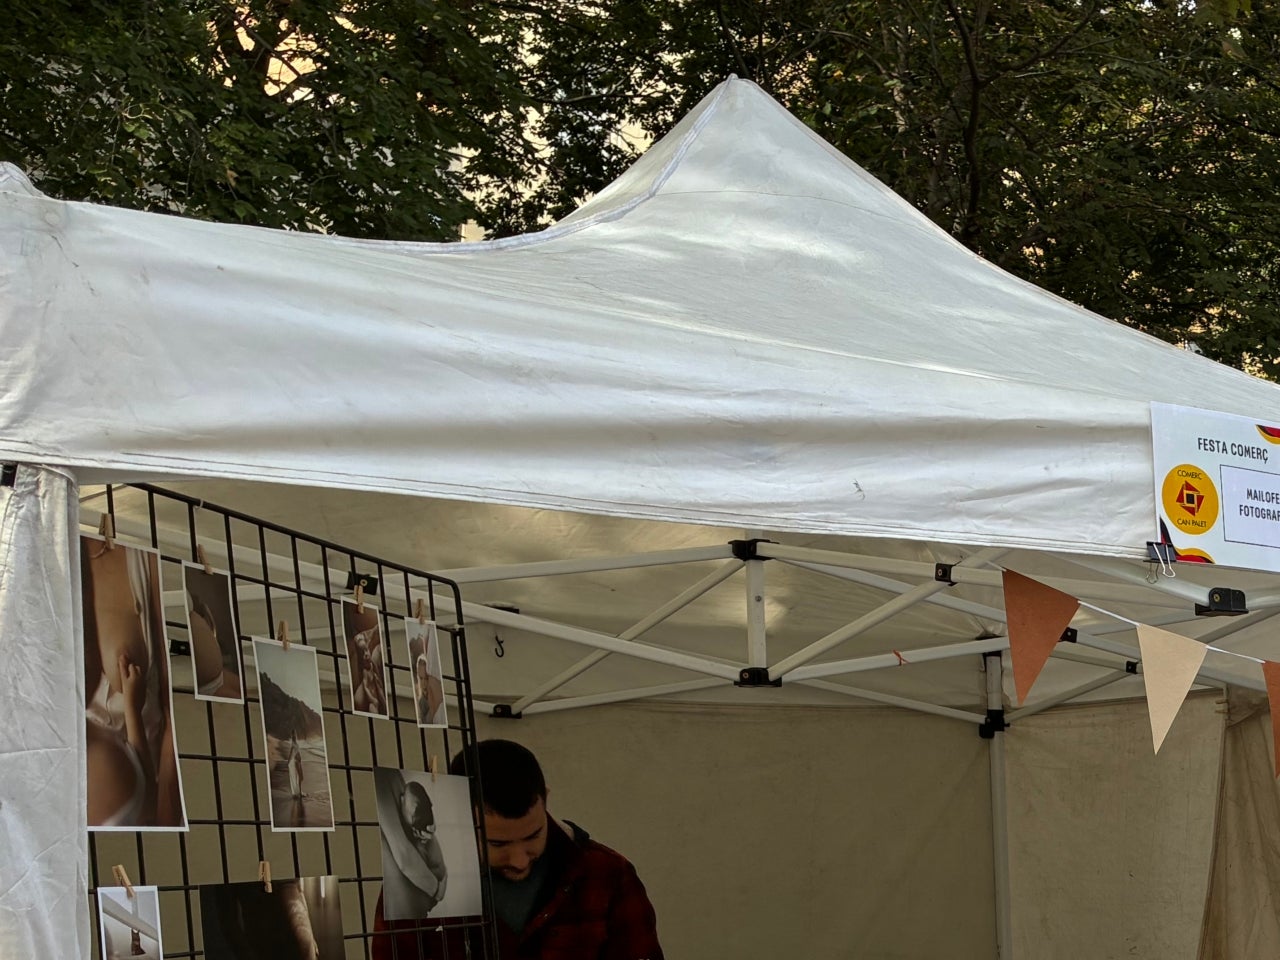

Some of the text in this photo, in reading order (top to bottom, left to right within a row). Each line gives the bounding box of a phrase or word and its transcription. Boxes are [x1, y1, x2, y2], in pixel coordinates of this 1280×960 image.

[1197, 437, 1269, 464] FESTA COMERÇ
[1246, 488, 1280, 505] MAILOFE
[1176, 518, 1191, 526] CAN
